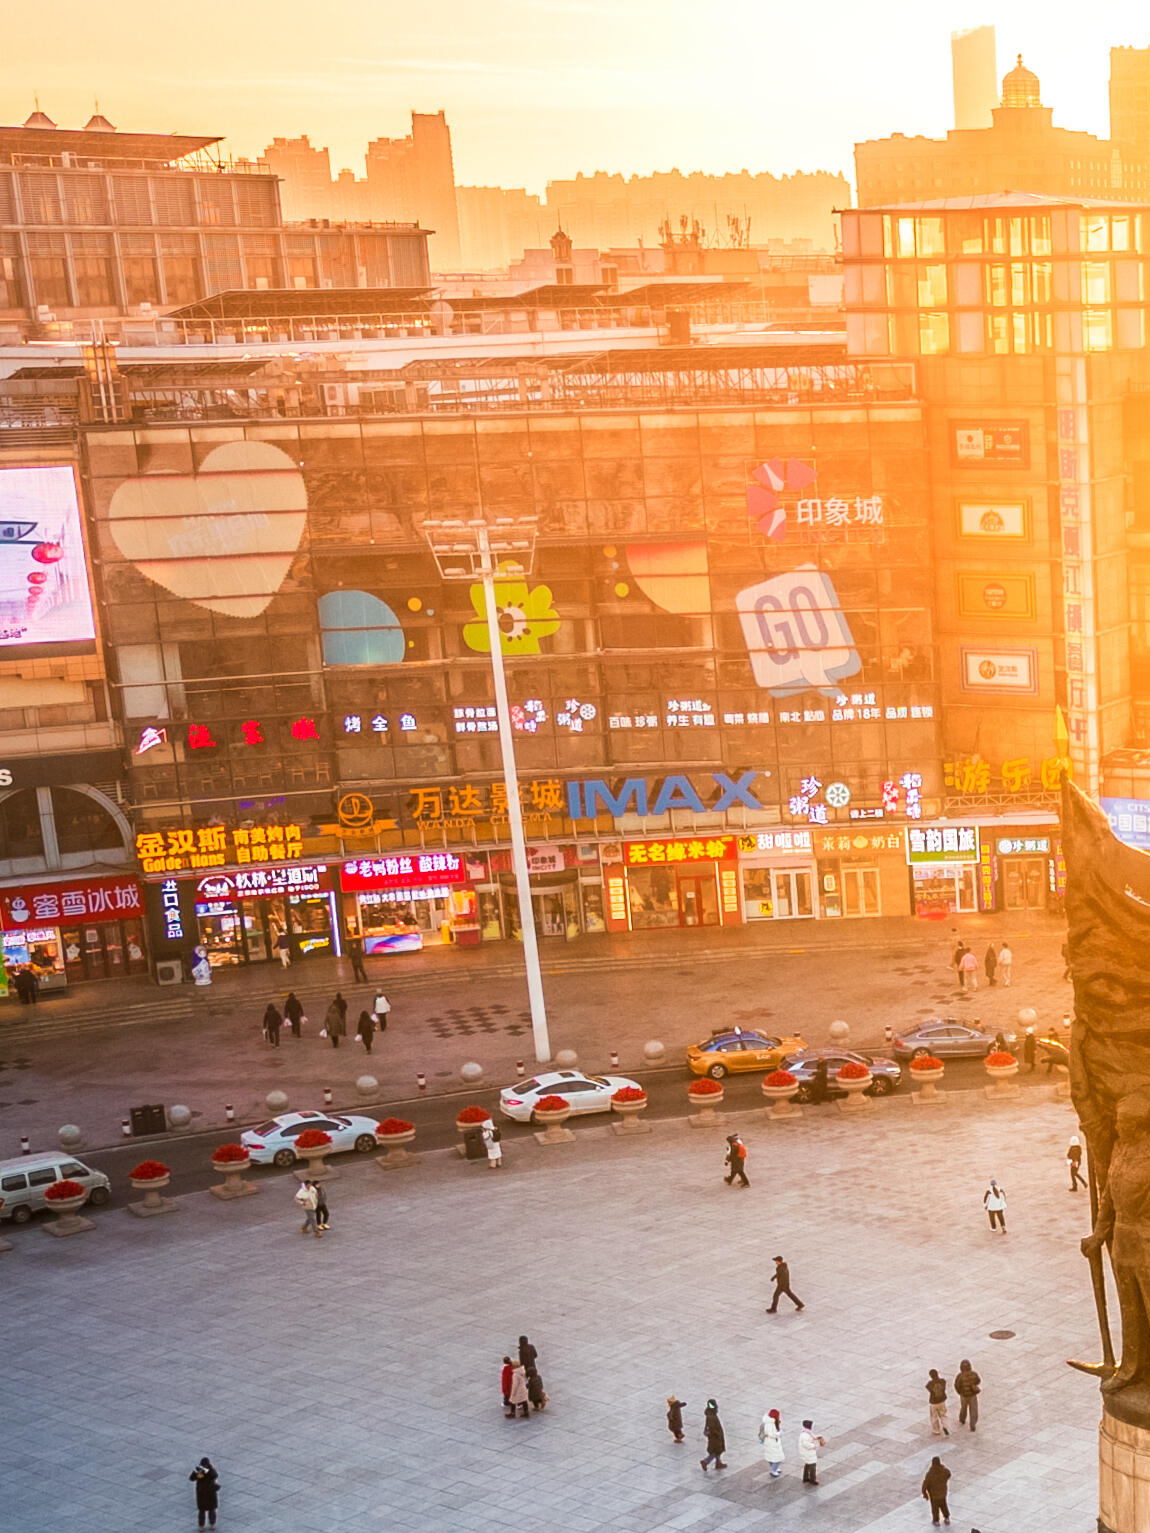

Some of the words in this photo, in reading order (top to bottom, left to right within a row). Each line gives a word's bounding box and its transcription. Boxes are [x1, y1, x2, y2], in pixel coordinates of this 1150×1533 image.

[797, 495, 883, 526] 印象城
[754, 585, 830, 666] GO
[344, 713, 417, 733] 烤全鱼
[566, 770, 764, 819] IMAX
[788, 775, 829, 824] 珍粥道
[416, 818, 477, 831] WANDA
[490, 812, 552, 826] CIEMA
[136, 826, 227, 859] 金汉斯
[232, 824, 302, 845] 南美烤肉
[757, 831, 811, 850] 甜啦啦
[872, 834, 900, 849] 奶白
[910, 827, 975, 853] 雪韵国旅
[236, 842, 303, 864] 自助餐厅
[628, 839, 727, 863] 无名缘米粉
[359, 856, 414, 878] 老鸭粉丝
[418, 853, 460, 873] 酸辣粉
[32, 883, 141, 920] 蜜雪冰城
